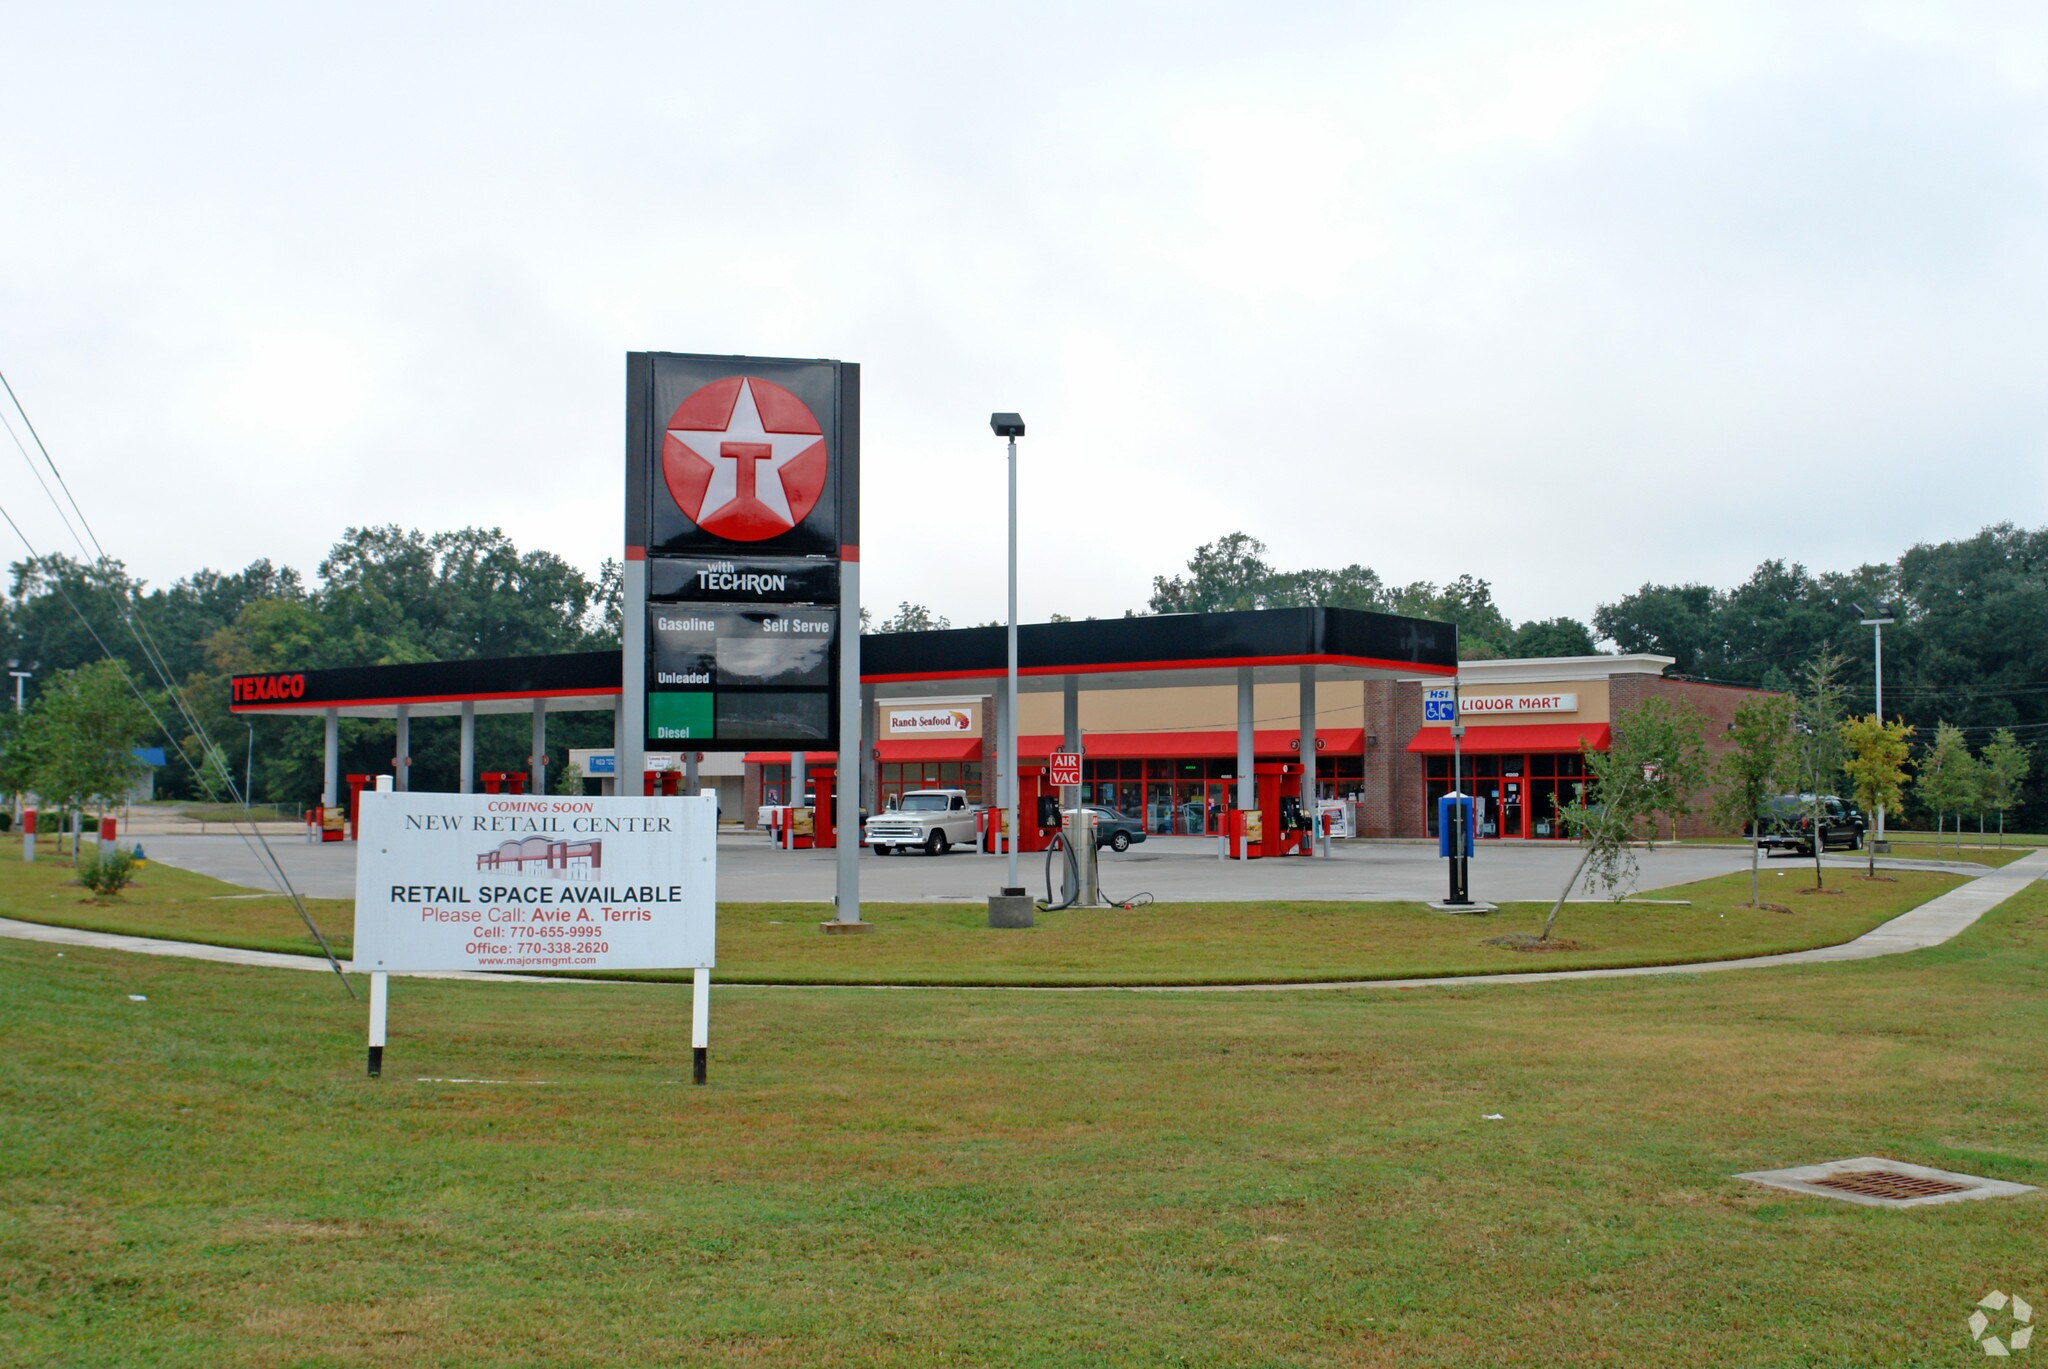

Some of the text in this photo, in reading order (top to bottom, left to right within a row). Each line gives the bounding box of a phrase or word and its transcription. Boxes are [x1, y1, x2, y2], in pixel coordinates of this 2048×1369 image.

[708, 561, 734, 574] with
[697, 571, 785, 594] TECHRON
[658, 617, 715, 632] Gasoline
[763, 619, 829, 633] Self Serve
[658, 672, 710, 684] Unleaded
[231, 674, 304, 701] TEXACO
[1430, 690, 1449, 699] HSI
[1461, 697, 1561, 711] LIQUOR MART
[892, 715, 951, 728] Ranch Seafood
[658, 726, 690, 739] Diesel
[1054, 755, 1077, 767] AIR
[1053, 771, 1079, 784] VAC
[487, 801, 593, 814] COMING SOON
[405, 814, 672, 832] NEW RETAIL CENTER
[390, 886, 682, 904] RETAIL SPACE AVAILABLE
[421, 907, 652, 923] Please Call: Avie A. Terris
[473, 926, 602, 938] Cell: 770-655-9995
[465, 942, 609, 954] Office: 770-338-2620
[478, 956, 596, 966] www.majorsmgmt.com
